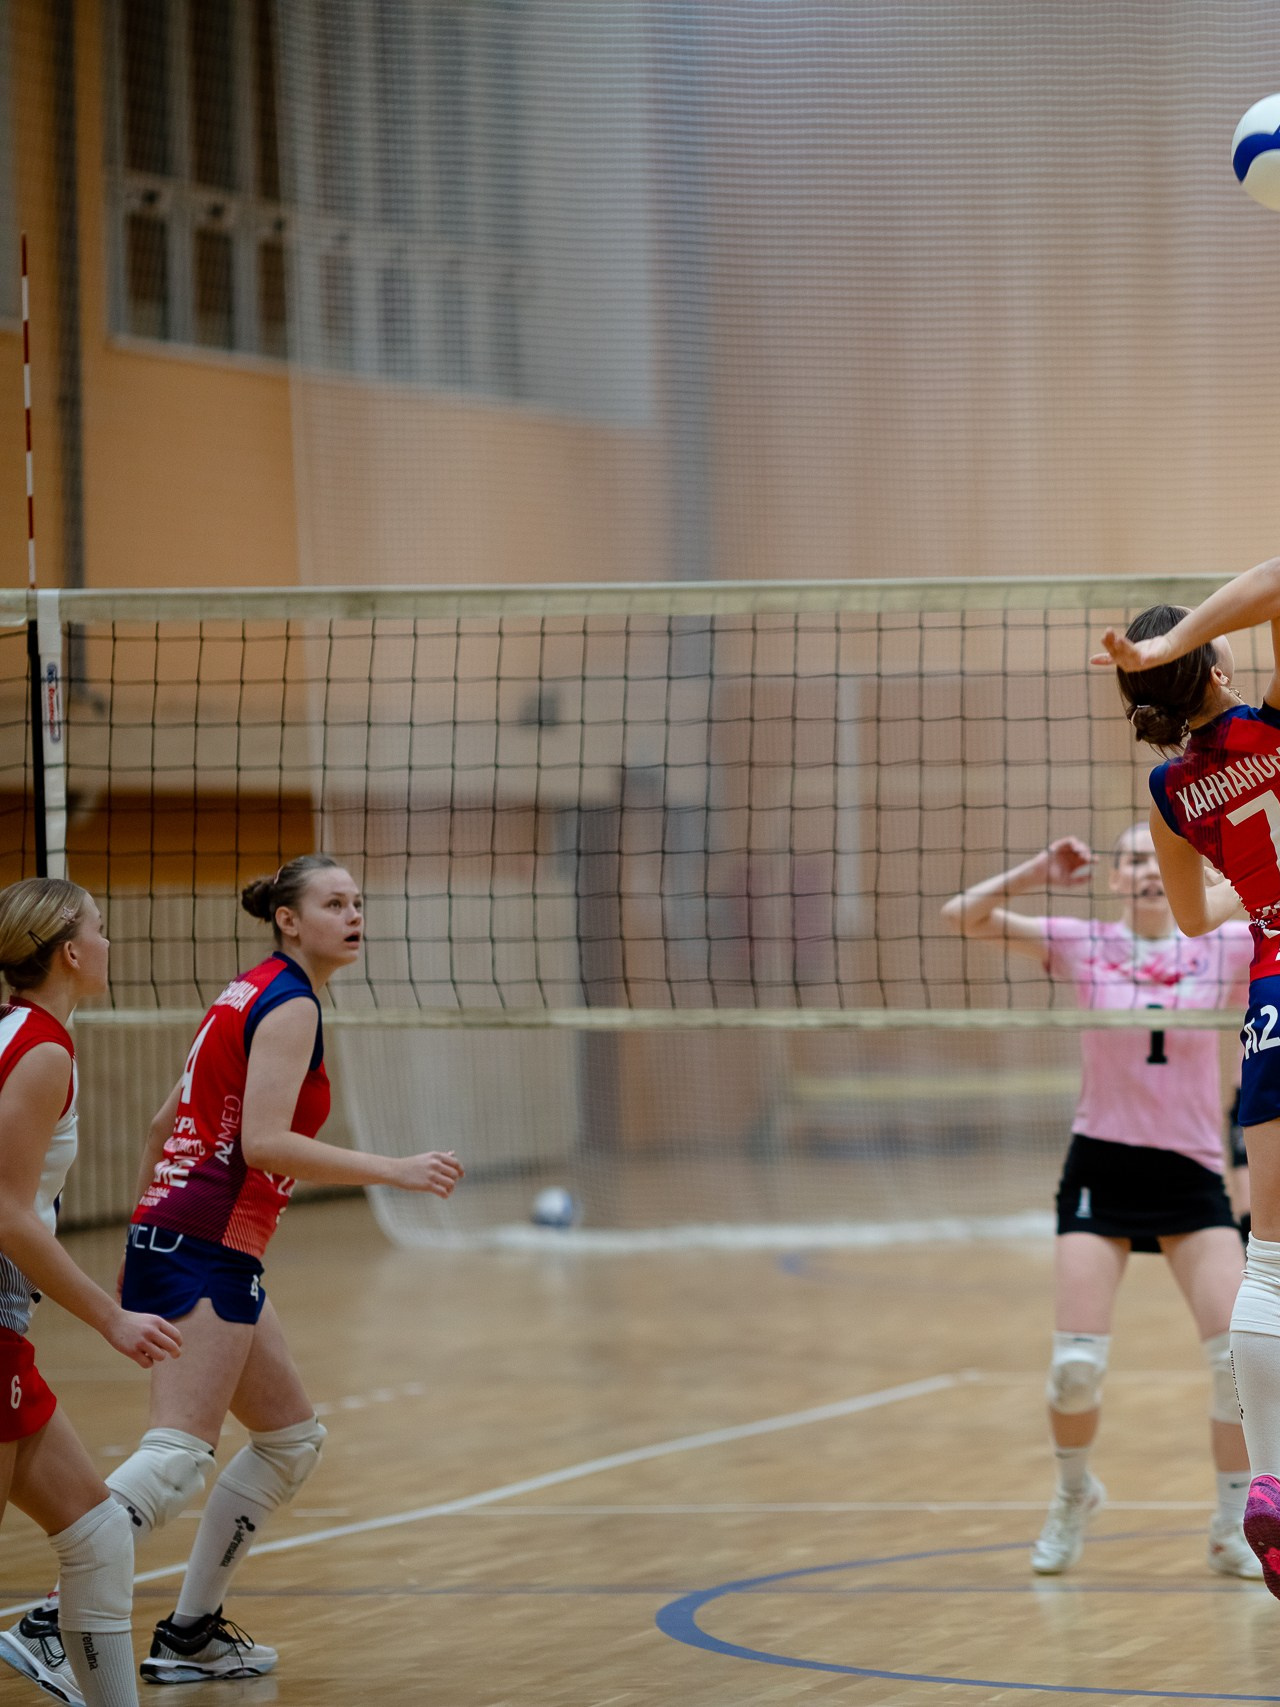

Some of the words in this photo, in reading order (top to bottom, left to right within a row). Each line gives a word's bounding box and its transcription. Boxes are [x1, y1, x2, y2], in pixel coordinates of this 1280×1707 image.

[180, 1014, 217, 1105] 4
[214, 1094, 242, 1166] A2MED
[249, 1273, 260, 1302] 4
[10, 1375, 22, 1410] 6
